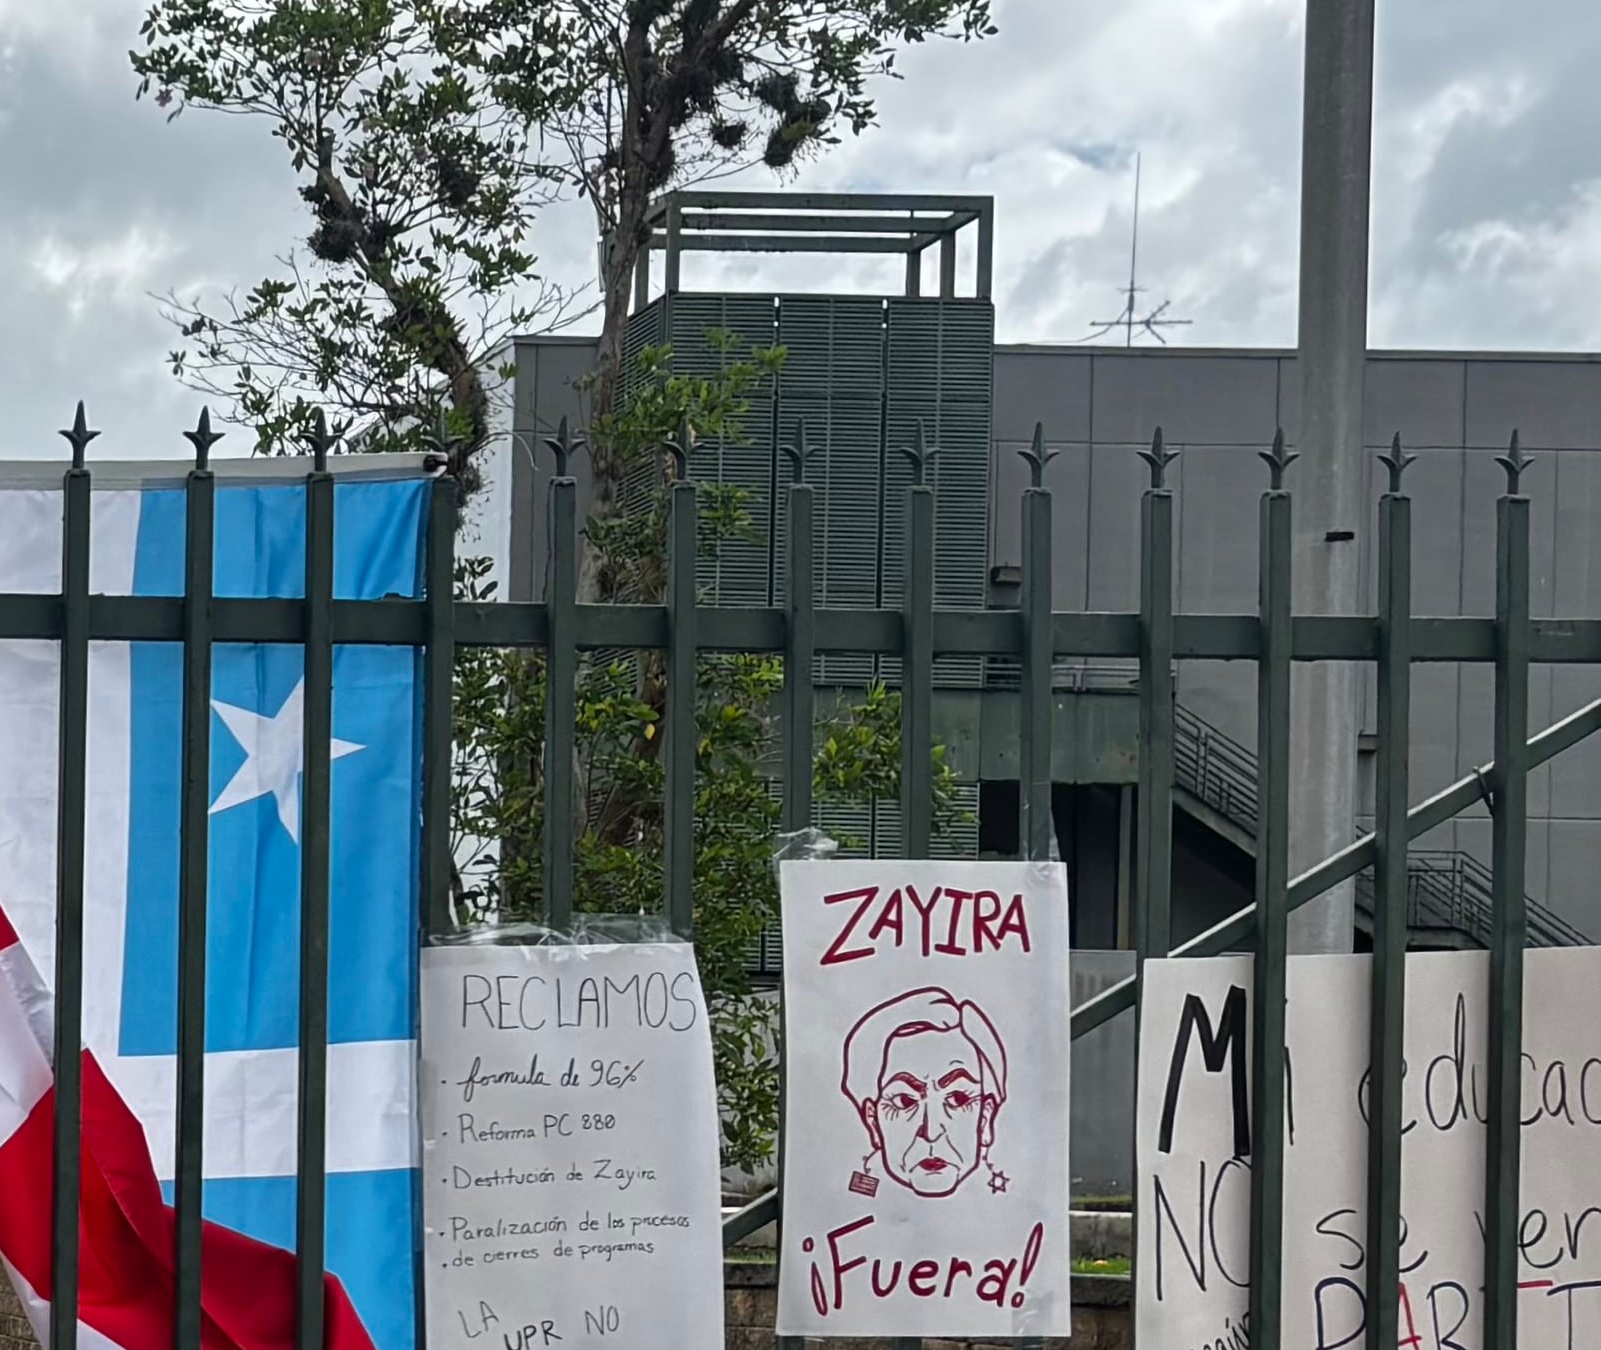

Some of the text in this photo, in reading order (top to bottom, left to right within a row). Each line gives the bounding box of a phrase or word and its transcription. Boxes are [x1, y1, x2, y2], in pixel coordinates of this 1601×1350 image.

[820, 884, 1031, 966] ZAYIRA
[462, 971, 696, 1032] RECLAMOS
[456, 1054, 645, 1102] formula de 96%
[457, 1113, 536, 1144] Reforma
[543, 1113, 573, 1138] PC
[453, 1159, 657, 1191] Destitución de Zayira
[448, 1213, 567, 1242] Paralización
[579, 1210, 600, 1232] de
[608, 1212, 625, 1229] los
[452, 1250, 474, 1268] de
[553, 1240, 573, 1257] de
[577, 1242, 655, 1262] programas
[802, 1214, 1044, 1316] ¡Fuera!
[458, 1300, 500, 1339] LA
[585, 1305, 621, 1335] NO
